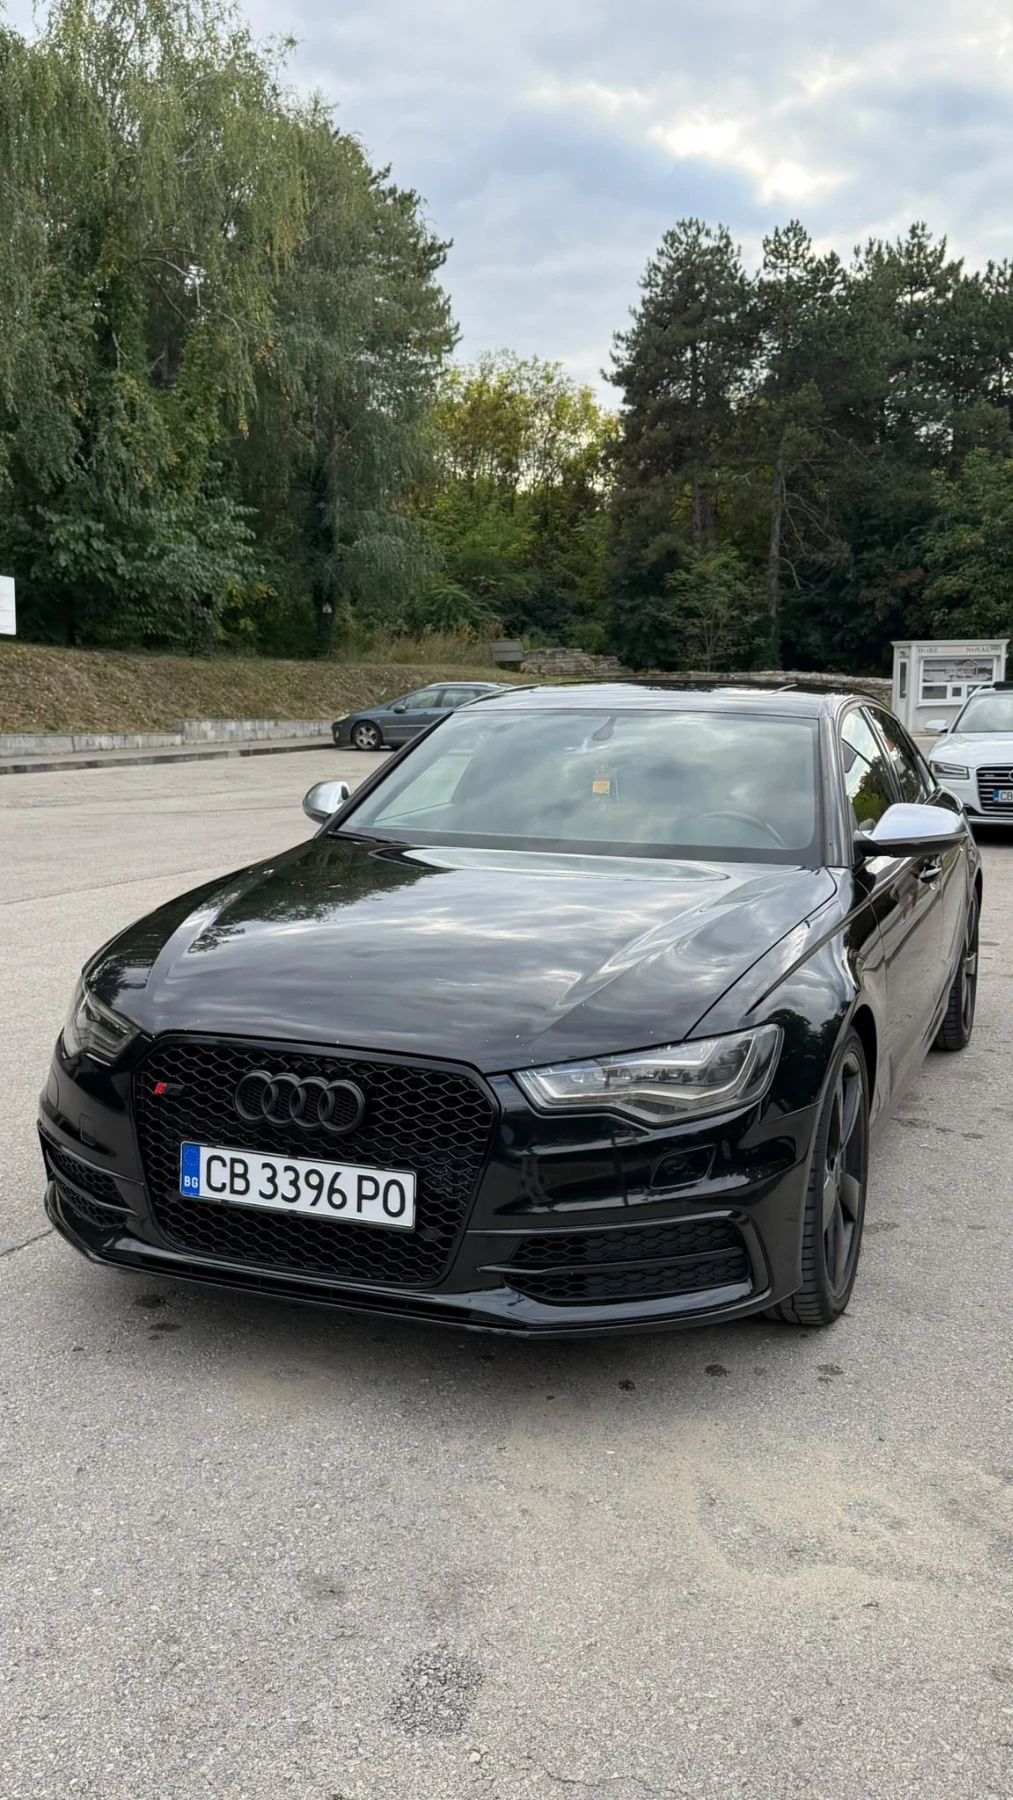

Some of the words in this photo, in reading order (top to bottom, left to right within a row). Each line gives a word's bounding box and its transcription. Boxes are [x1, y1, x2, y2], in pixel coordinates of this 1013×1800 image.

[184, 1176, 199, 1189] BG
[205, 1154, 251, 1196] CB
[258, 1162, 348, 1210] 3396
[356, 1174, 406, 1218] PO
